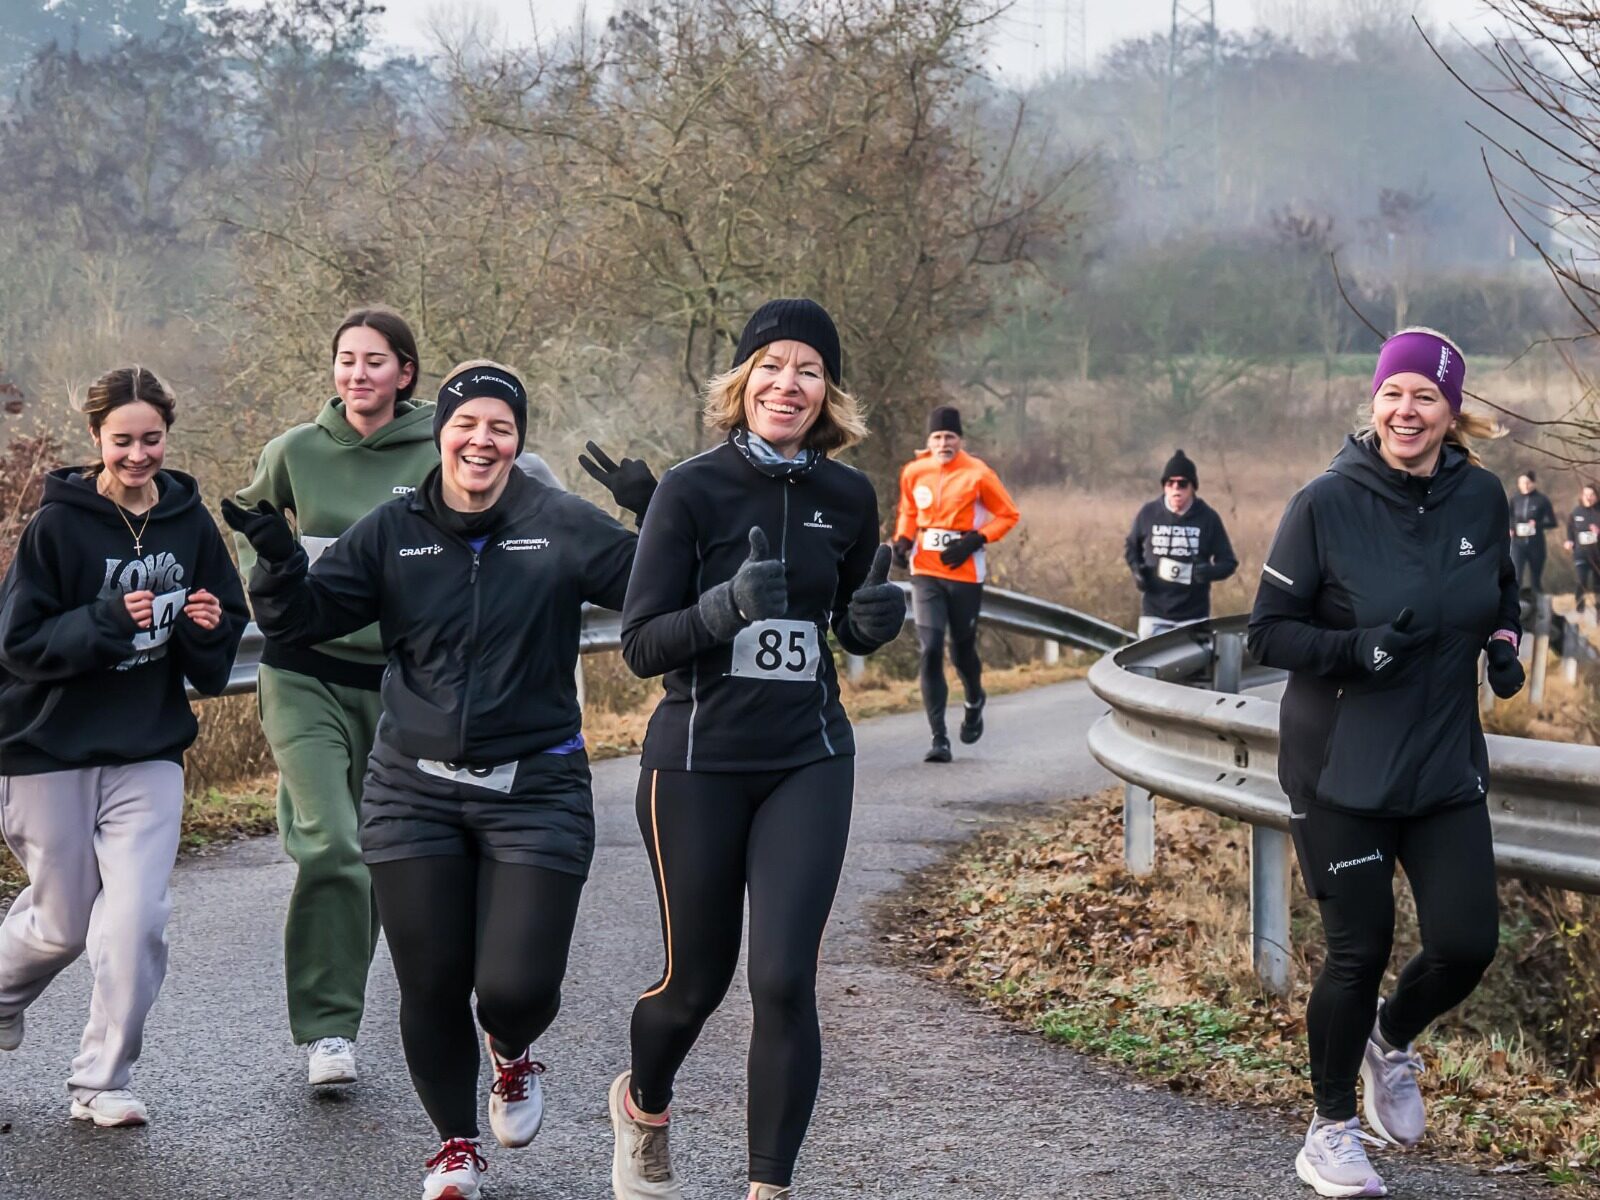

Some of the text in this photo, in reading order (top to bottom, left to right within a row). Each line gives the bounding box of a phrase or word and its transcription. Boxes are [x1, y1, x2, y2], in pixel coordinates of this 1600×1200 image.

[399, 546, 434, 557] CRAFT
[1170, 566, 1181, 579] 9
[755, 629, 807, 672] 85
[1336, 854, 1377, 869] RÜCKENWIND
